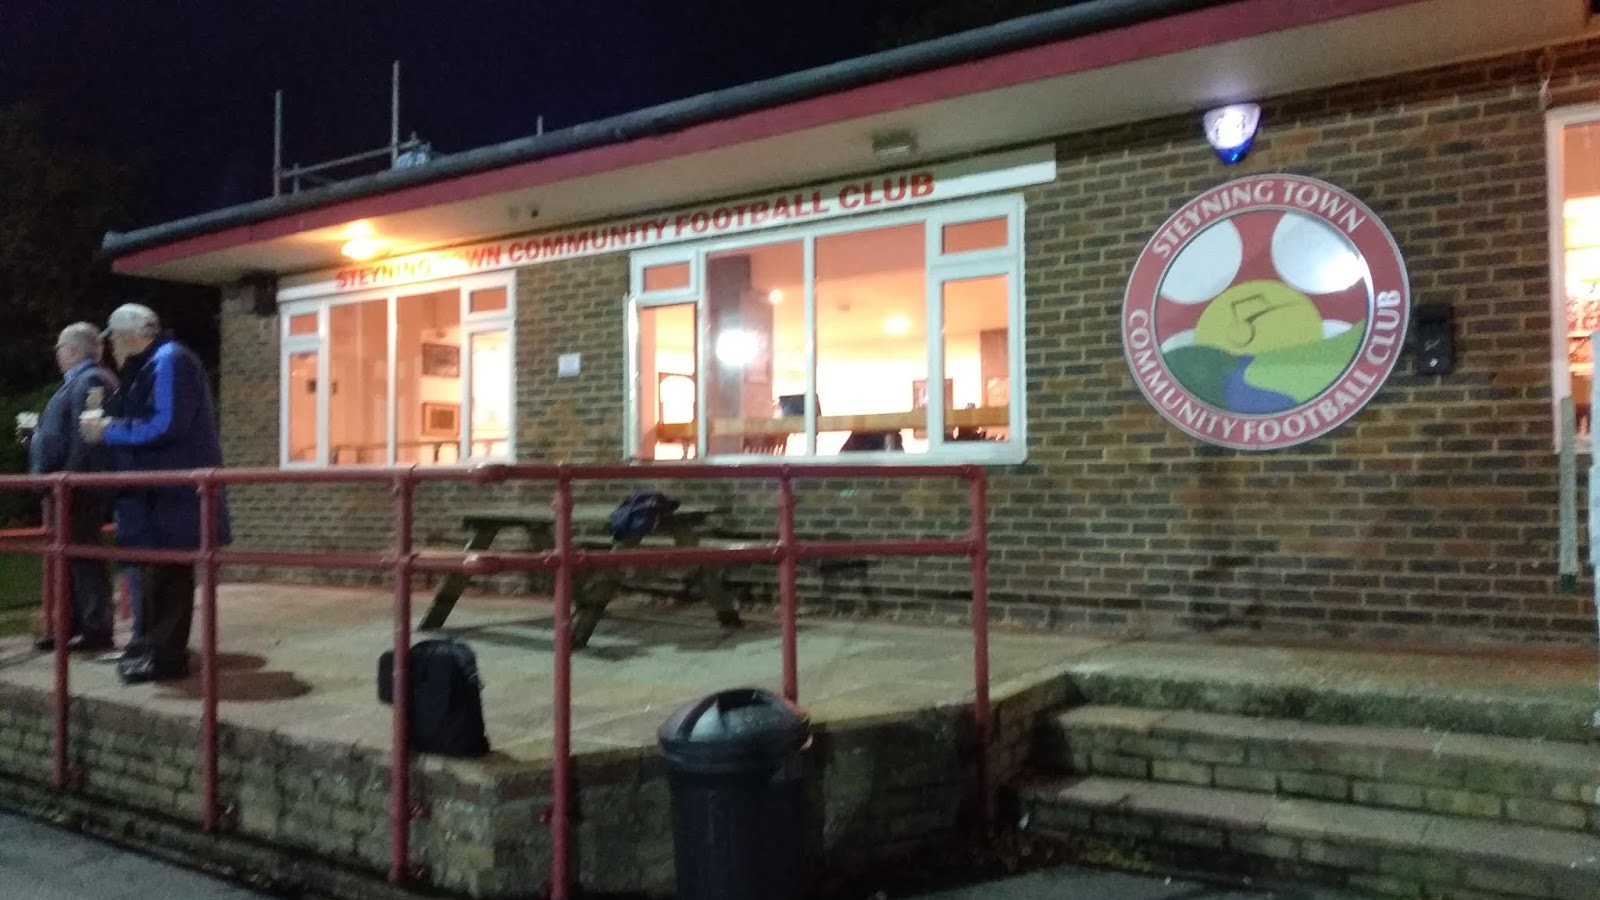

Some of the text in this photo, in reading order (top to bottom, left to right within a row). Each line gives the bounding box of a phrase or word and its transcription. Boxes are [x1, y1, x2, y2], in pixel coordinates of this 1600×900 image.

[336, 256, 432, 289] STEYNING
[509, 217, 668, 263] COMMUNITY
[674, 191, 830, 237] FOOTBALL
[838, 171, 935, 209] CLUB
[1152, 180, 1366, 259] STEYNING TOWN
[1128, 288, 1401, 443] COMMUNITY FOOTBALL CLUB
